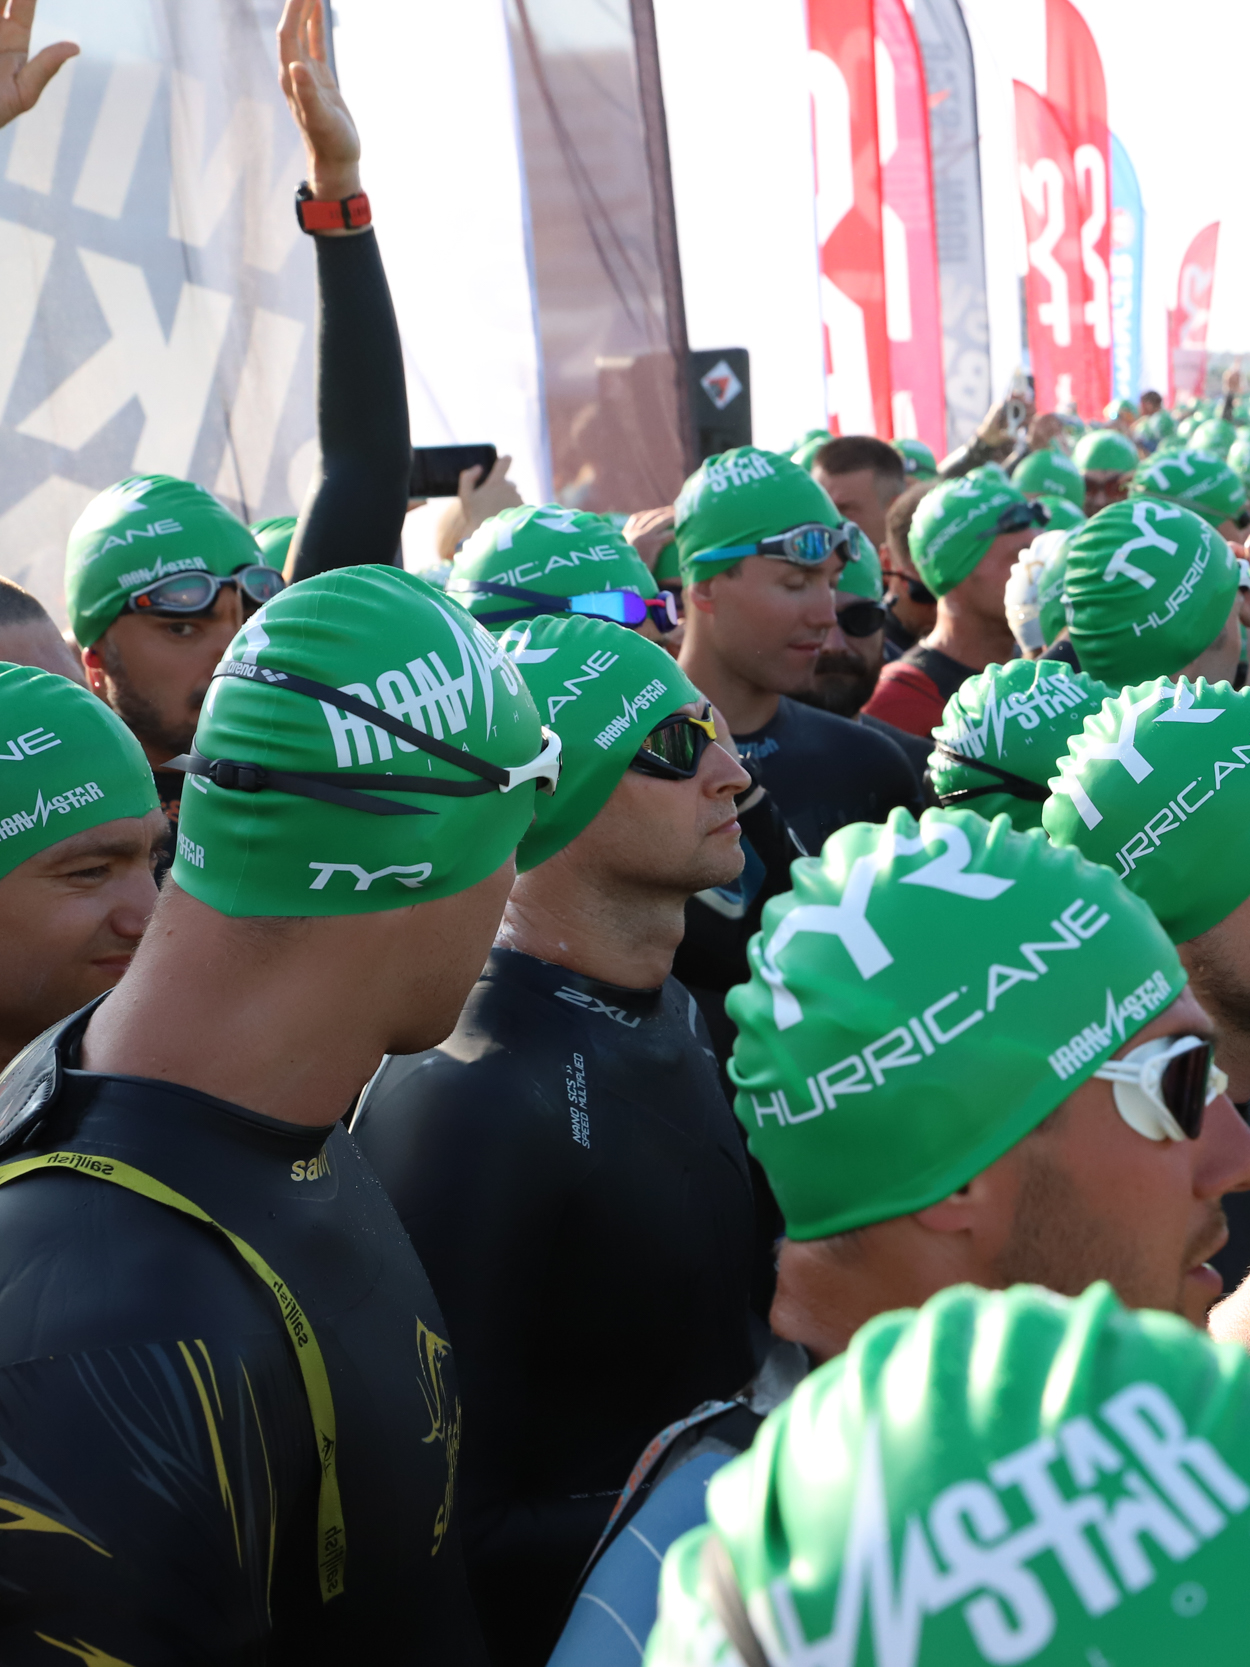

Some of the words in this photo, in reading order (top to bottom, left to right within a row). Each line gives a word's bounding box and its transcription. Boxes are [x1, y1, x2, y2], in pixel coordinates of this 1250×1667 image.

[1101, 500, 1182, 591] TYR
[226, 660, 258, 678] arena
[319, 650, 468, 768] IRON
[593, 714, 632, 751] IRON
[634, 678, 668, 711] STAR
[1005, 672, 1089, 731] STAR
[49, 781, 105, 815] STAR
[308, 861, 433, 891] TYR
[750, 822, 1017, 1032] TYR
[553, 985, 642, 1029] 2XU
[749, 897, 1112, 1129] HURRICANE
[1047, 1020, 1113, 1081] IRON
[1123, 969, 1172, 1023] STAR
[565, 1078, 578, 1104] SCS
[573, 1052, 588, 1110] MULTIPLIED
[569, 1106, 582, 1144] NANO
[580, 1111, 591, 1150] SPEED
